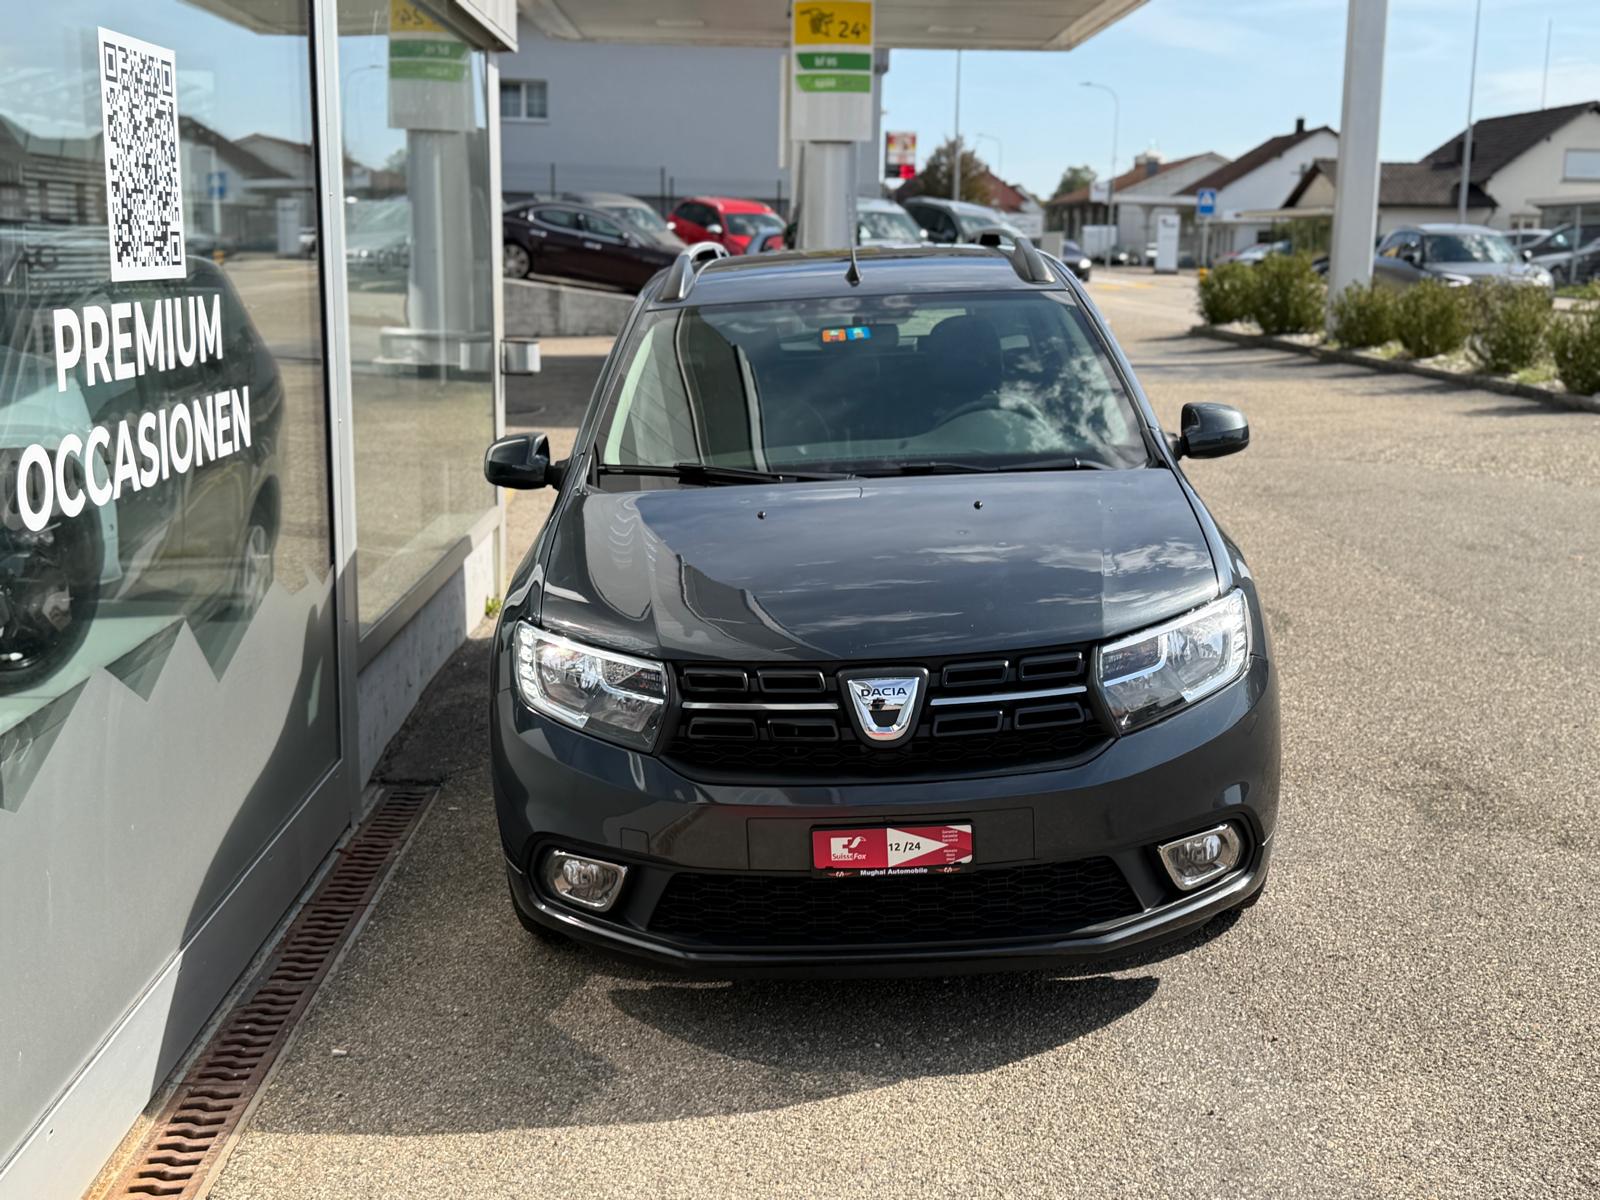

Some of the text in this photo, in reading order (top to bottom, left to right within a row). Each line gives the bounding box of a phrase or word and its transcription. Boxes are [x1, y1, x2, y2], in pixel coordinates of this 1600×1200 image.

[53, 294, 223, 392] PREMIUM
[17, 386, 251, 531] OCCASIONEN
[861, 687, 907, 697] DACIA
[888, 842, 901, 852] 12
[860, 867, 929, 877] Mughal Automobile
